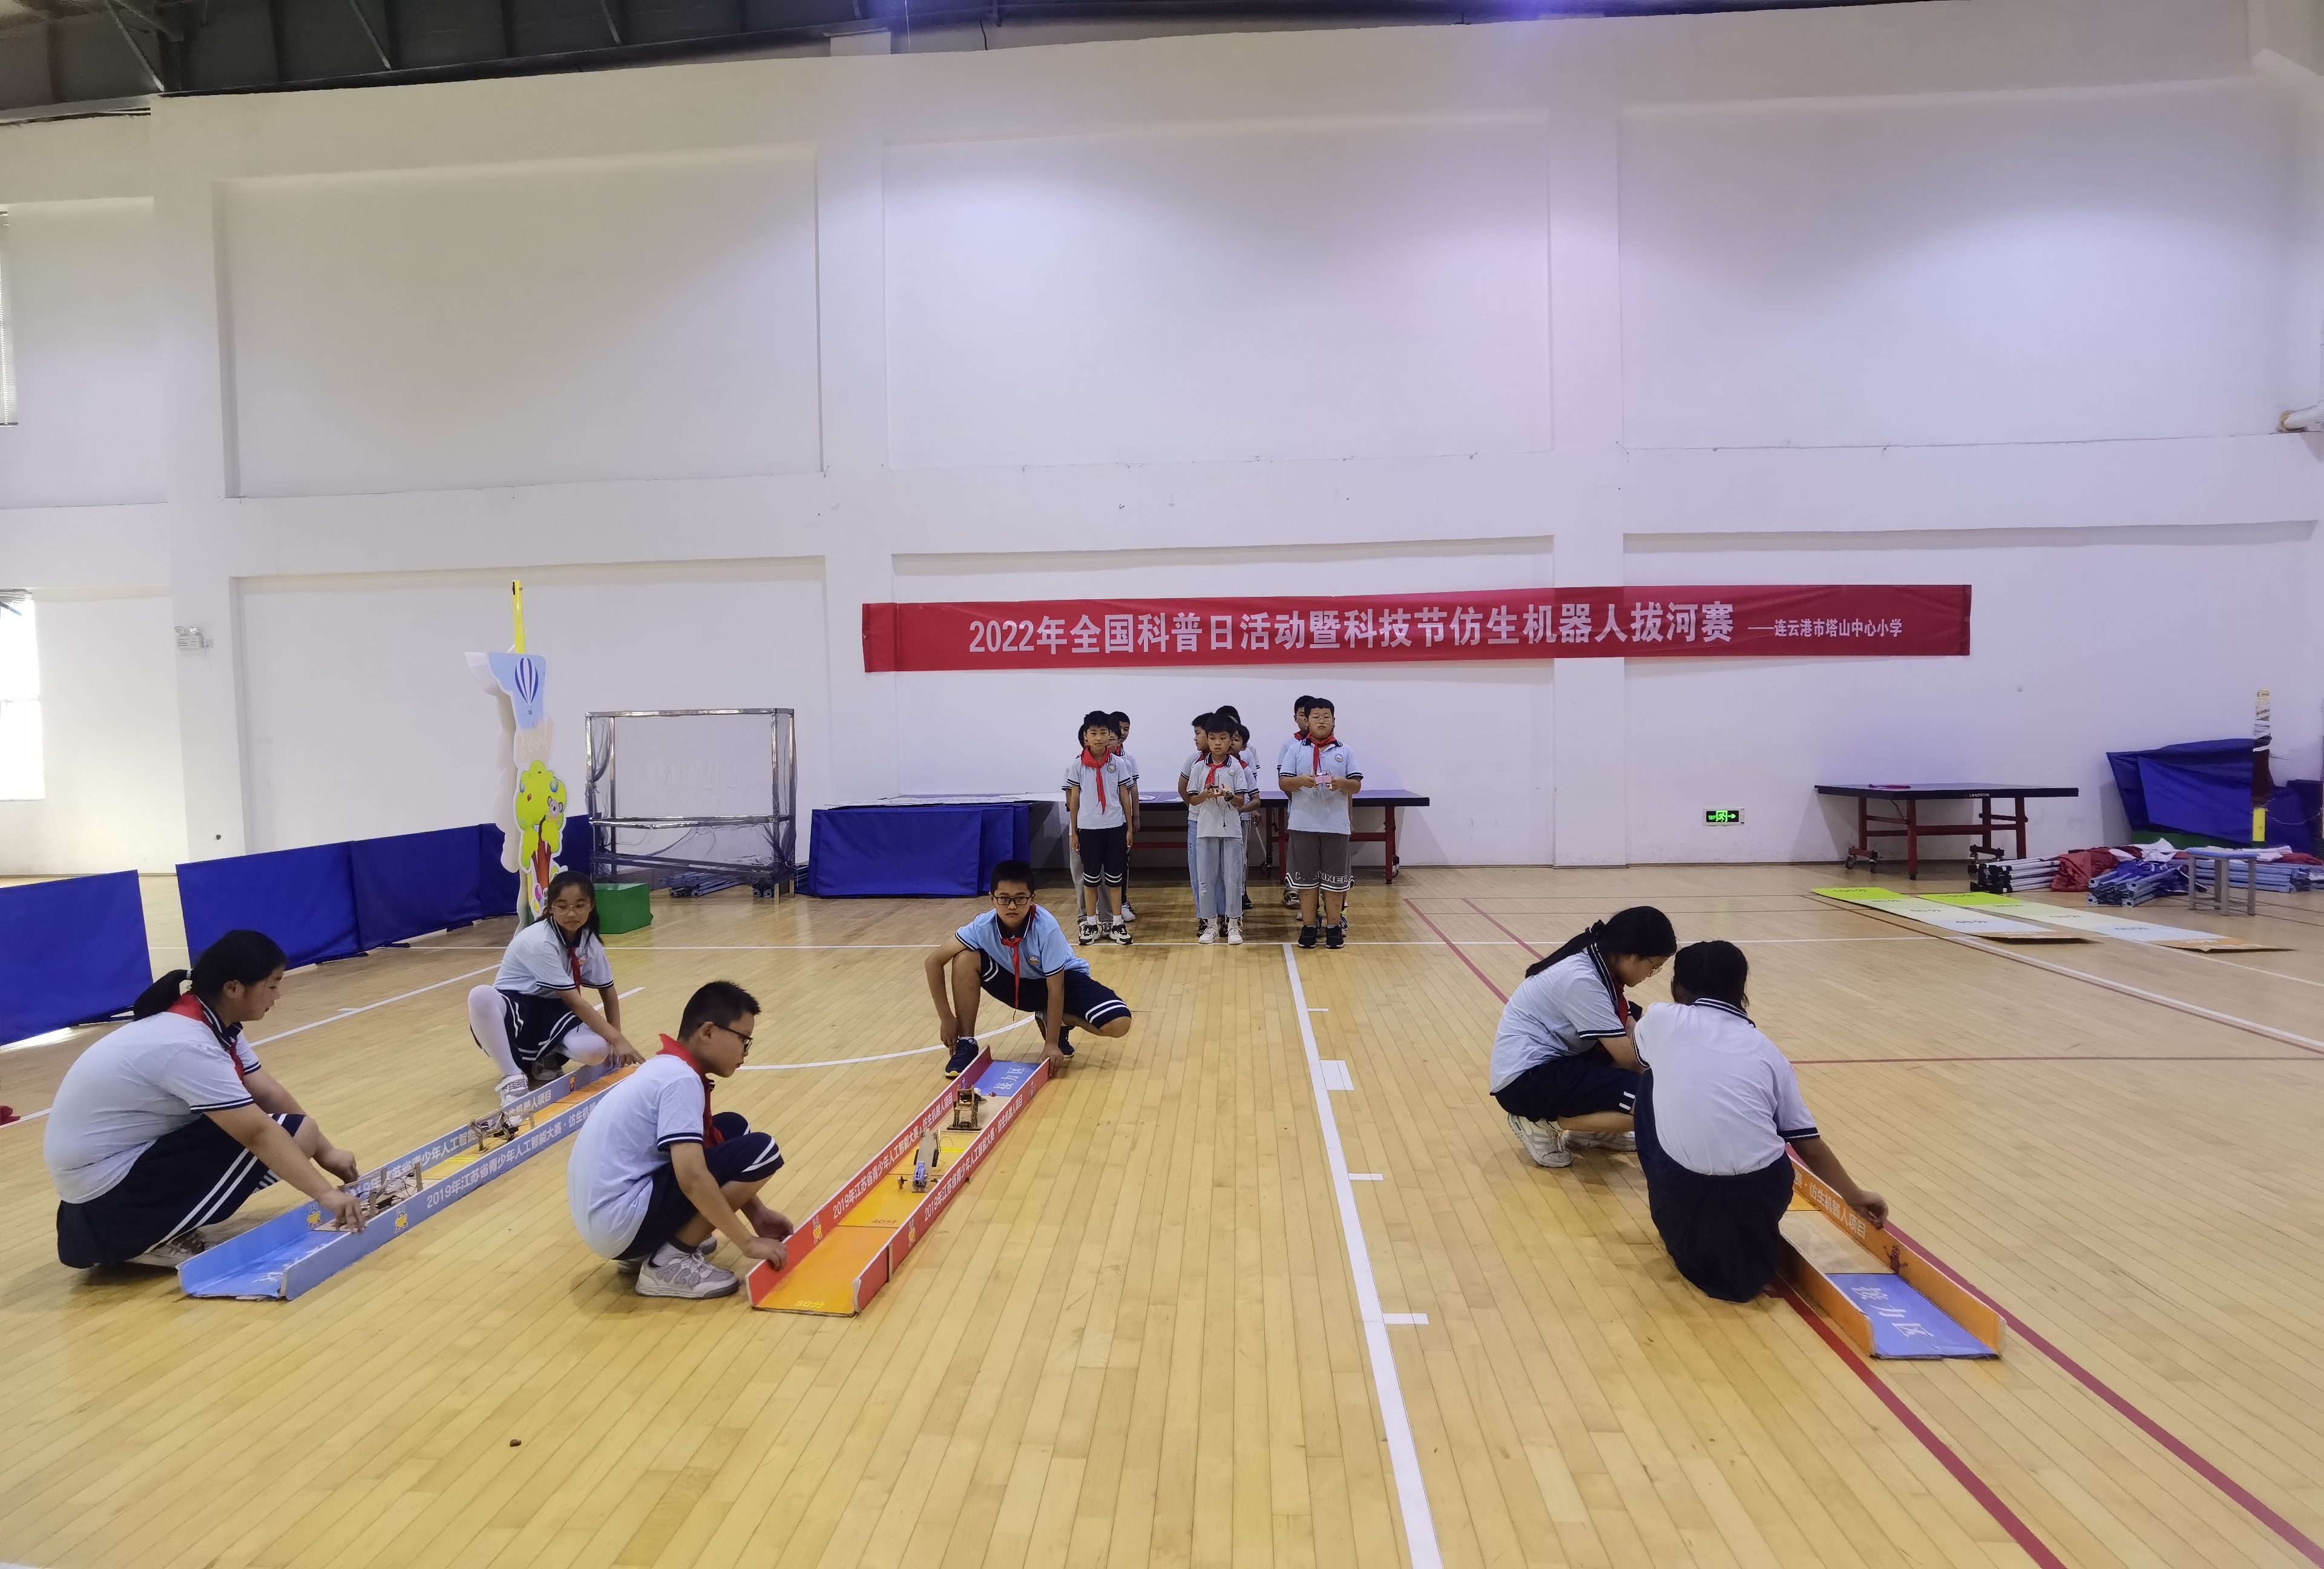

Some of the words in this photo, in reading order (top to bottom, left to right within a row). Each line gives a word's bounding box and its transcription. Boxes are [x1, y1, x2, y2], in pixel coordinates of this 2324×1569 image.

[969, 600, 1735, 655] 2022年全国科普日活动暨科技节仿生机器人拔河赛
[1851, 1287, 1934, 1338] 接力区
